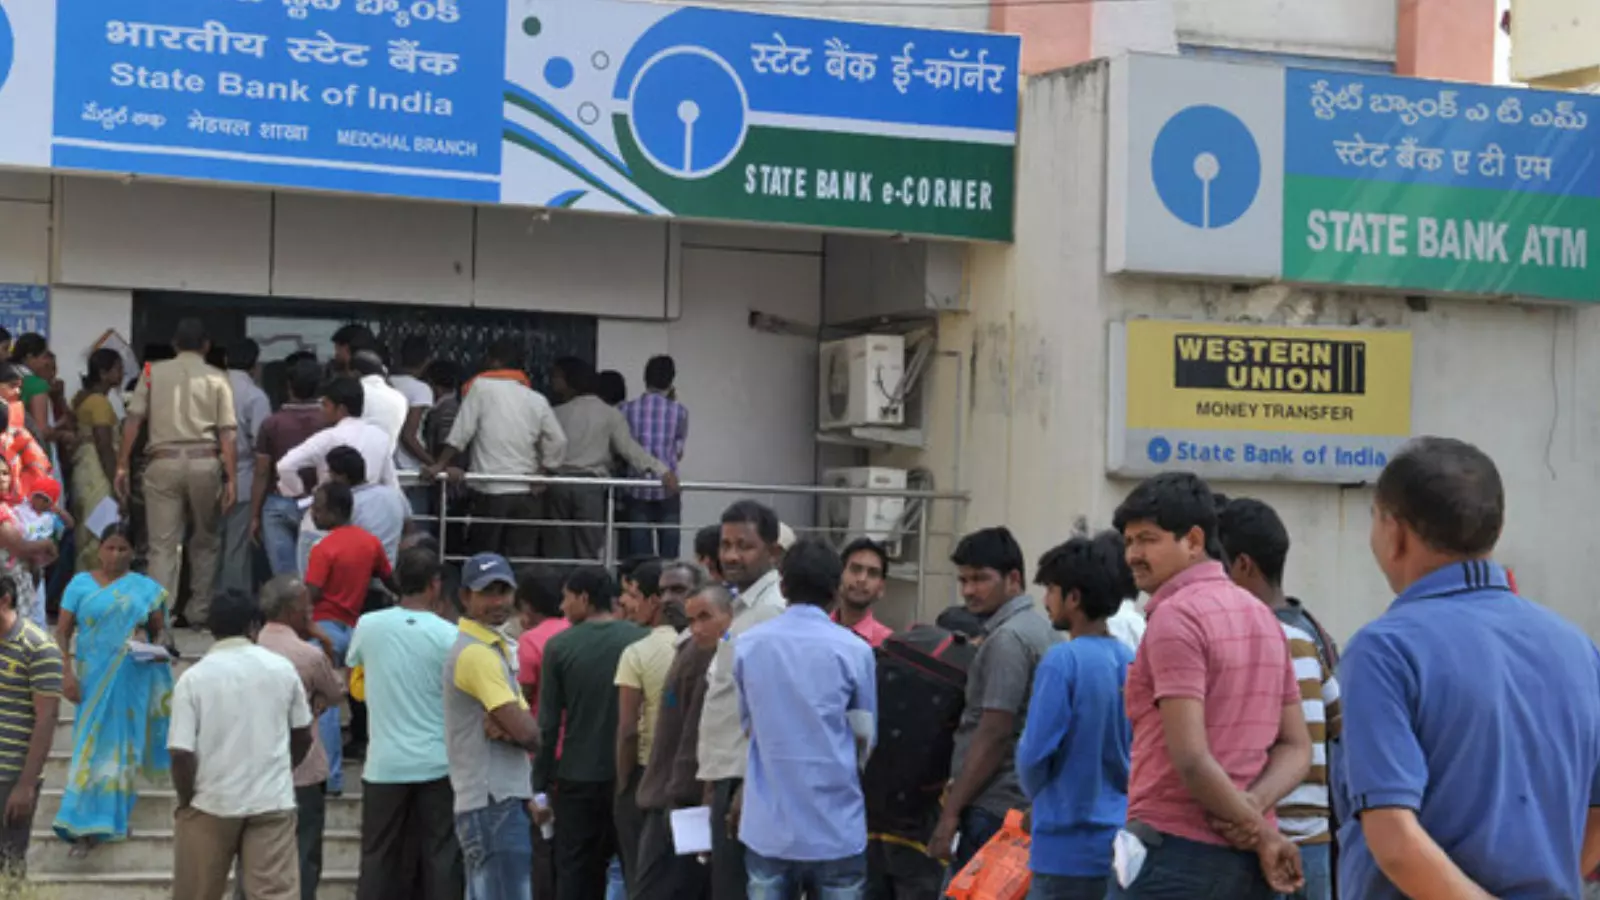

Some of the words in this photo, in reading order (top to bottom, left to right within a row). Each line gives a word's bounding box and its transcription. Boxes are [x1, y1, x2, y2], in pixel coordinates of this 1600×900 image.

[105, 20, 268, 58] भारतीय
[286, 30, 370, 67] स्टेट
[387, 38, 460, 76] बैंक
[750, 32, 812, 76] स्टेट
[824, 36, 878, 83] बैंक
[109, 62, 206, 93] State
[217, 72, 310, 103] Bank
[321, 83, 360, 108] of
[368, 86, 454, 116] India
[336, 128, 411, 153] MEDCHAL
[412, 135, 478, 158] BRANCH
[1333, 131, 1390, 168] स्टेट
[1395, 135, 1445, 173] बैंक
[1452, 148, 1471, 177] ए
[1478, 142, 1505, 178] टी
[1513, 152, 1552, 182] एम
[743, 162, 808, 199] STATE
[815, 170, 874, 203] BANK
[881, 174, 994, 211] e-CORNER
[1305, 207, 1408, 257] STATE
[1416, 216, 1509, 264] BANK
[1520, 224, 1588, 270] ATM
[1177, 337, 1332, 365] WESTERN
[1226, 366, 1332, 392] UNION
[1195, 400, 1259, 419] MONEY
[1262, 403, 1355, 422] TRANSFER
[1175, 440, 1236, 463] State
[1242, 442, 1294, 465] Bank
[1301, 444, 1328, 465] of
[1334, 445, 1388, 468] India
